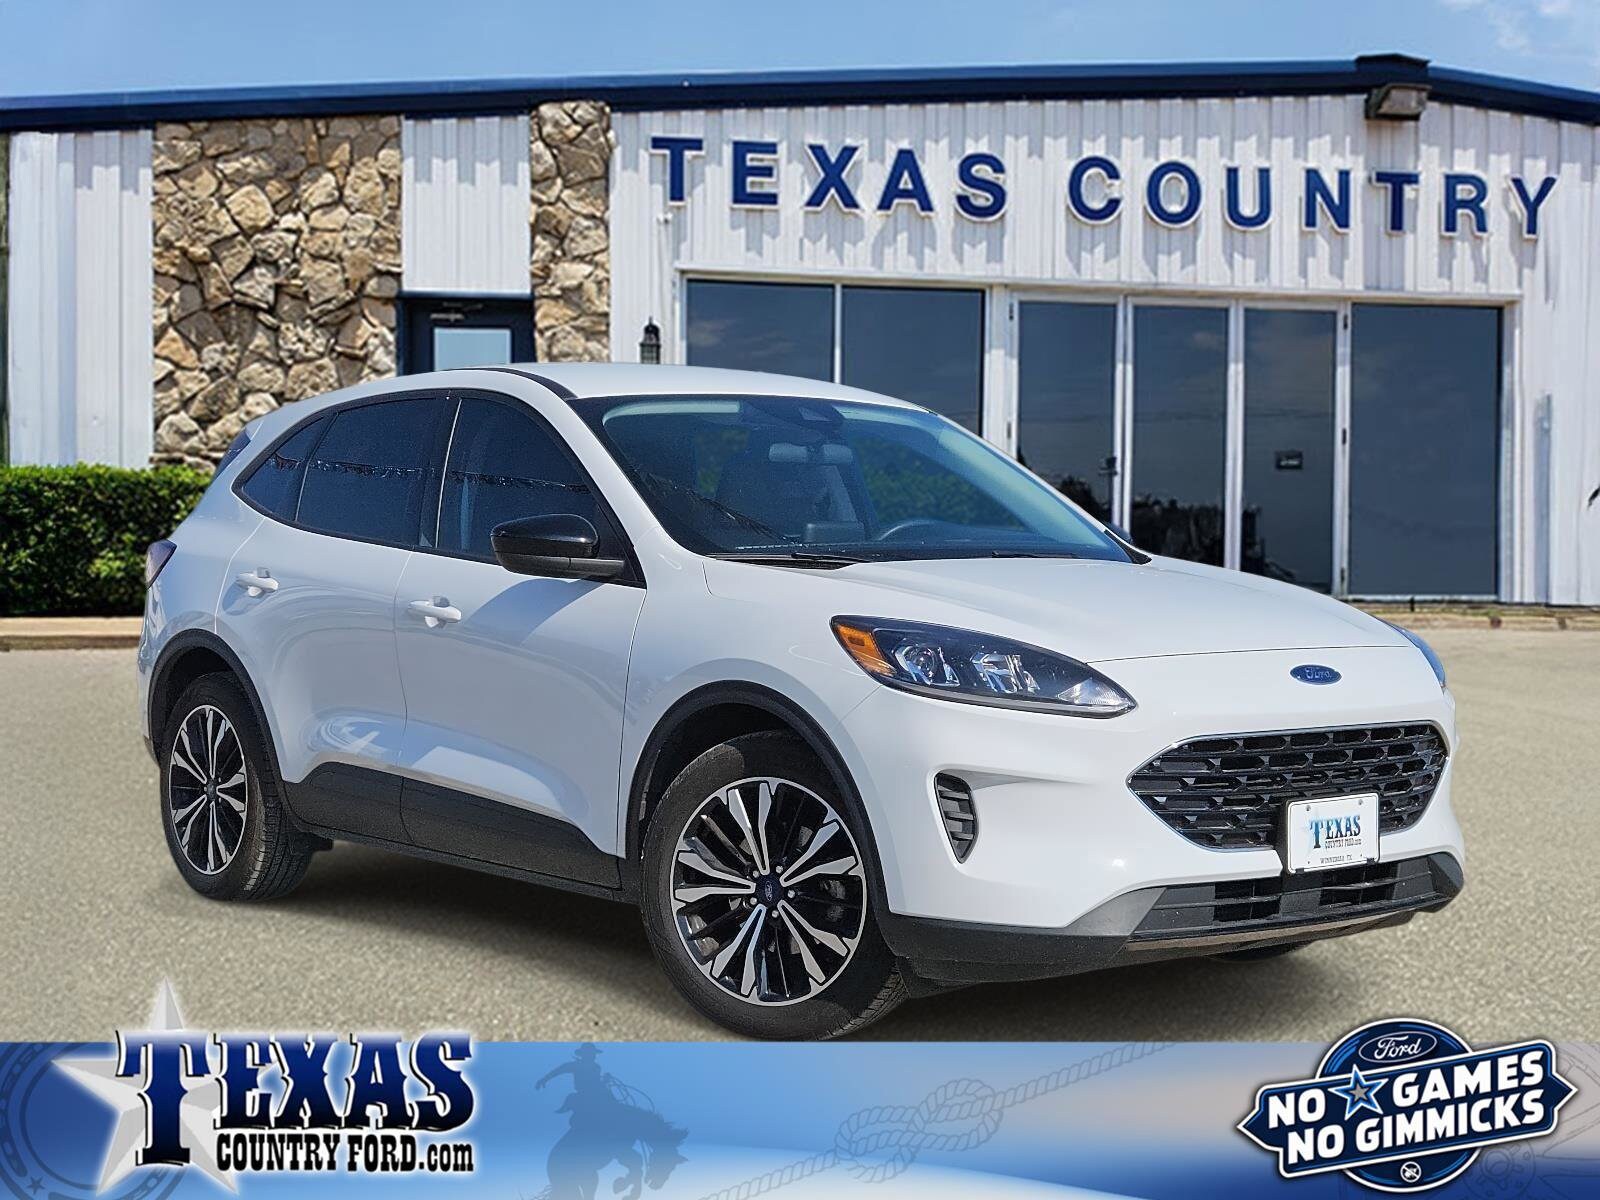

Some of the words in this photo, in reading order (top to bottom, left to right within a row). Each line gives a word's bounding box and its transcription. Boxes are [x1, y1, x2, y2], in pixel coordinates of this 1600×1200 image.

[651, 135, 1008, 221] TEXAS
[1068, 155, 1557, 240] COUNTRY
[1310, 815, 1361, 849] TEXAS
